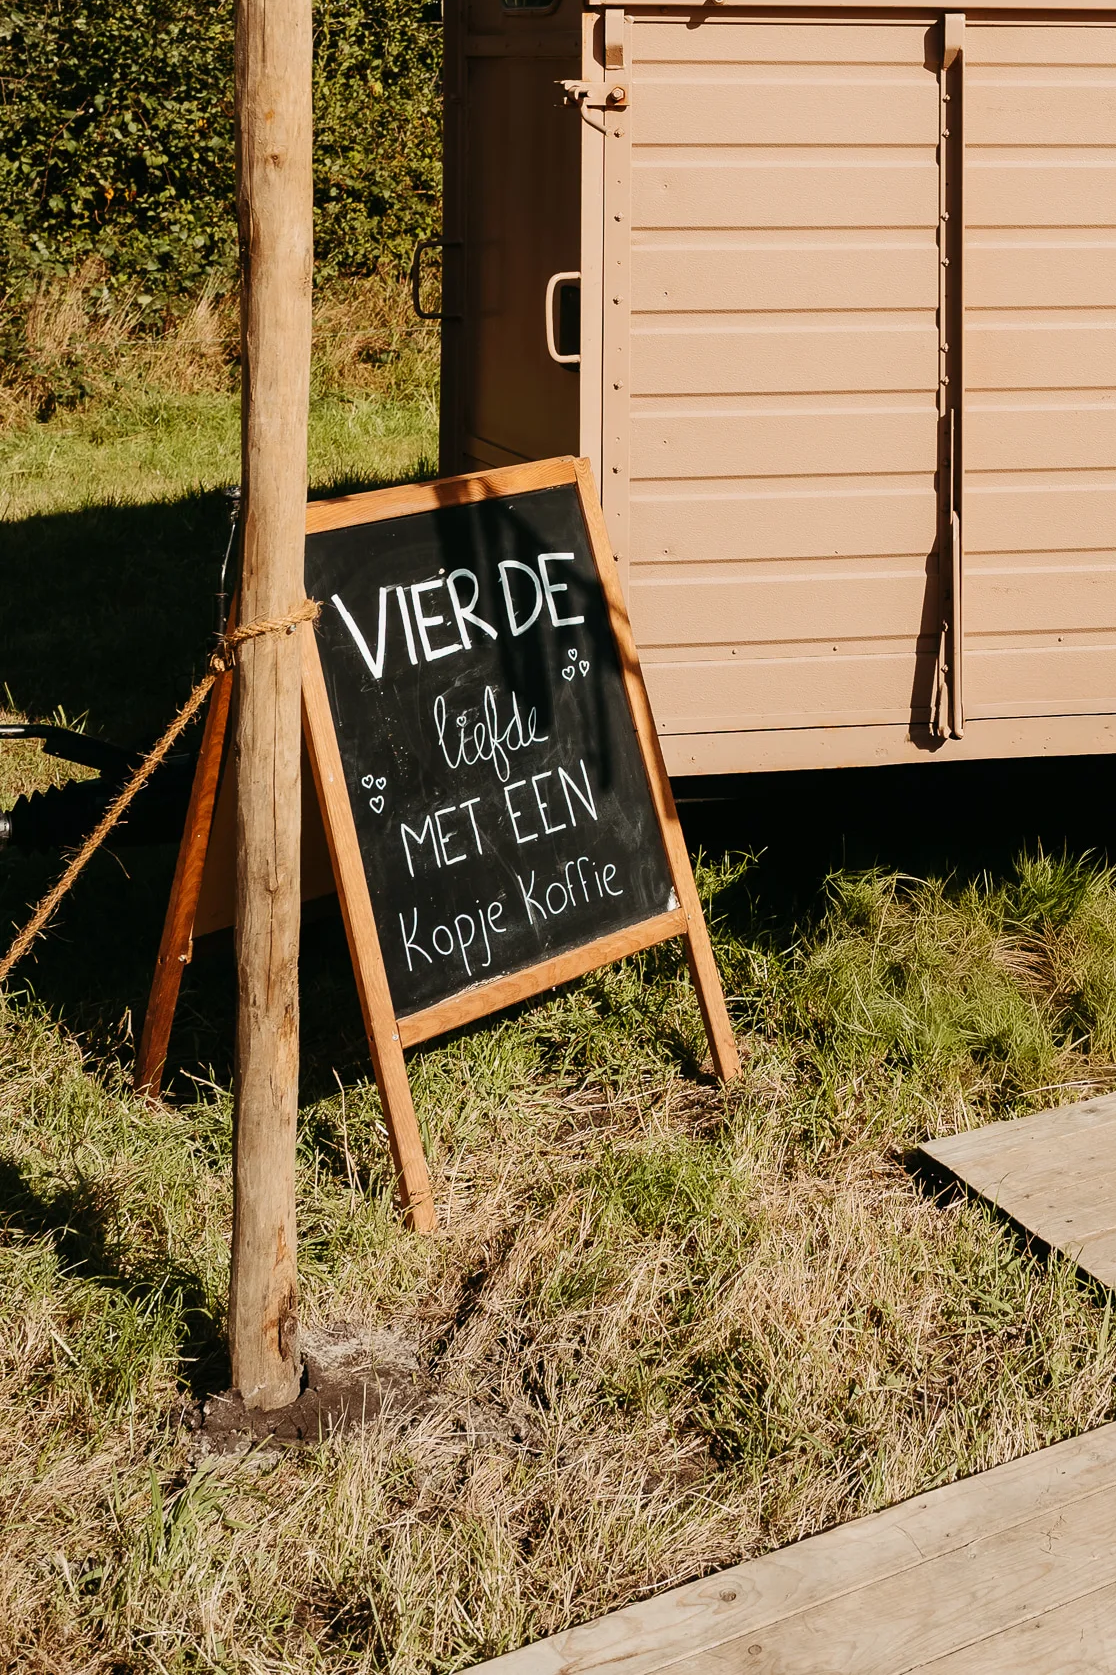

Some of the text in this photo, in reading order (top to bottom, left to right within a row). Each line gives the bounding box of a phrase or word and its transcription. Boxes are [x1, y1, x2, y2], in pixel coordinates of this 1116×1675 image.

[433, 686, 549, 782] liefde
[400, 760, 599, 878] MET EEN
[399, 856, 624, 976] Kopje Koffie
